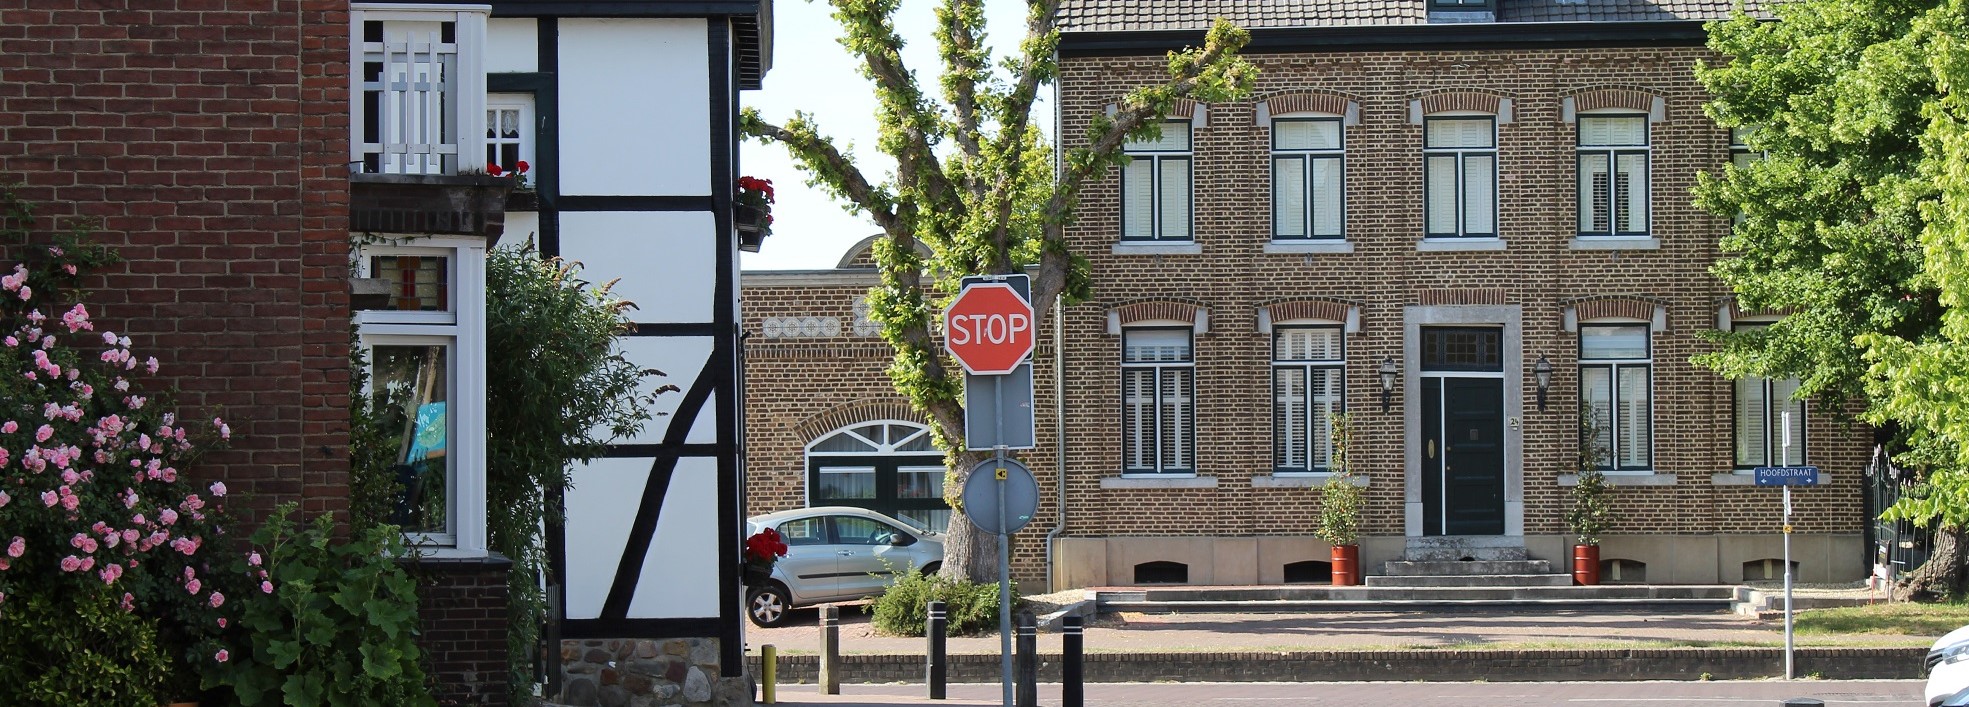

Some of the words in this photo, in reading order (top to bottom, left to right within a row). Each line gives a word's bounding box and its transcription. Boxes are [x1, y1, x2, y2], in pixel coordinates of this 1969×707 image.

[951, 313, 1029, 345] STOP
[1510, 417, 1519, 425] 24
[1760, 468, 1812, 477] HOOFDSTRAAT
